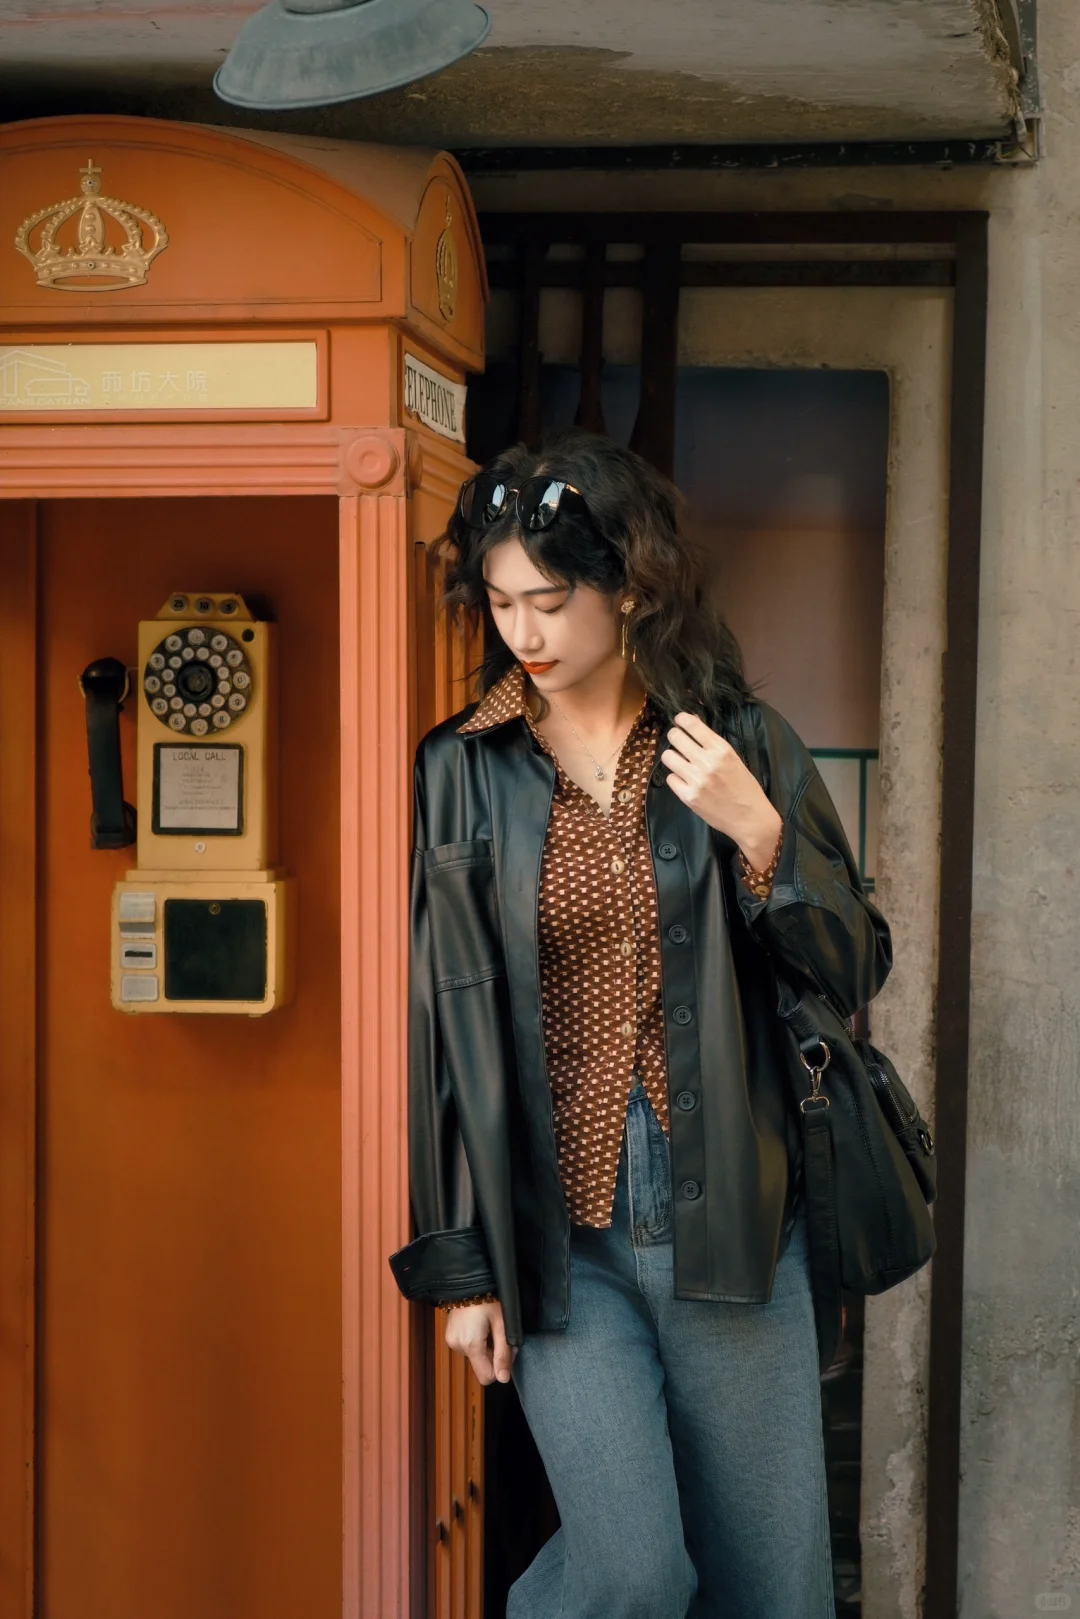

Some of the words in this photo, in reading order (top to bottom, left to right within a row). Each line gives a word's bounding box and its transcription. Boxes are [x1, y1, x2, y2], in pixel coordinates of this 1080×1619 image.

[102, 370, 209, 392] 西坊大院
[173, 599, 184, 608] 25
[199, 602, 209, 610] 10
[172, 751, 200, 761] LOCAL
[204, 751, 226, 761] CALL
